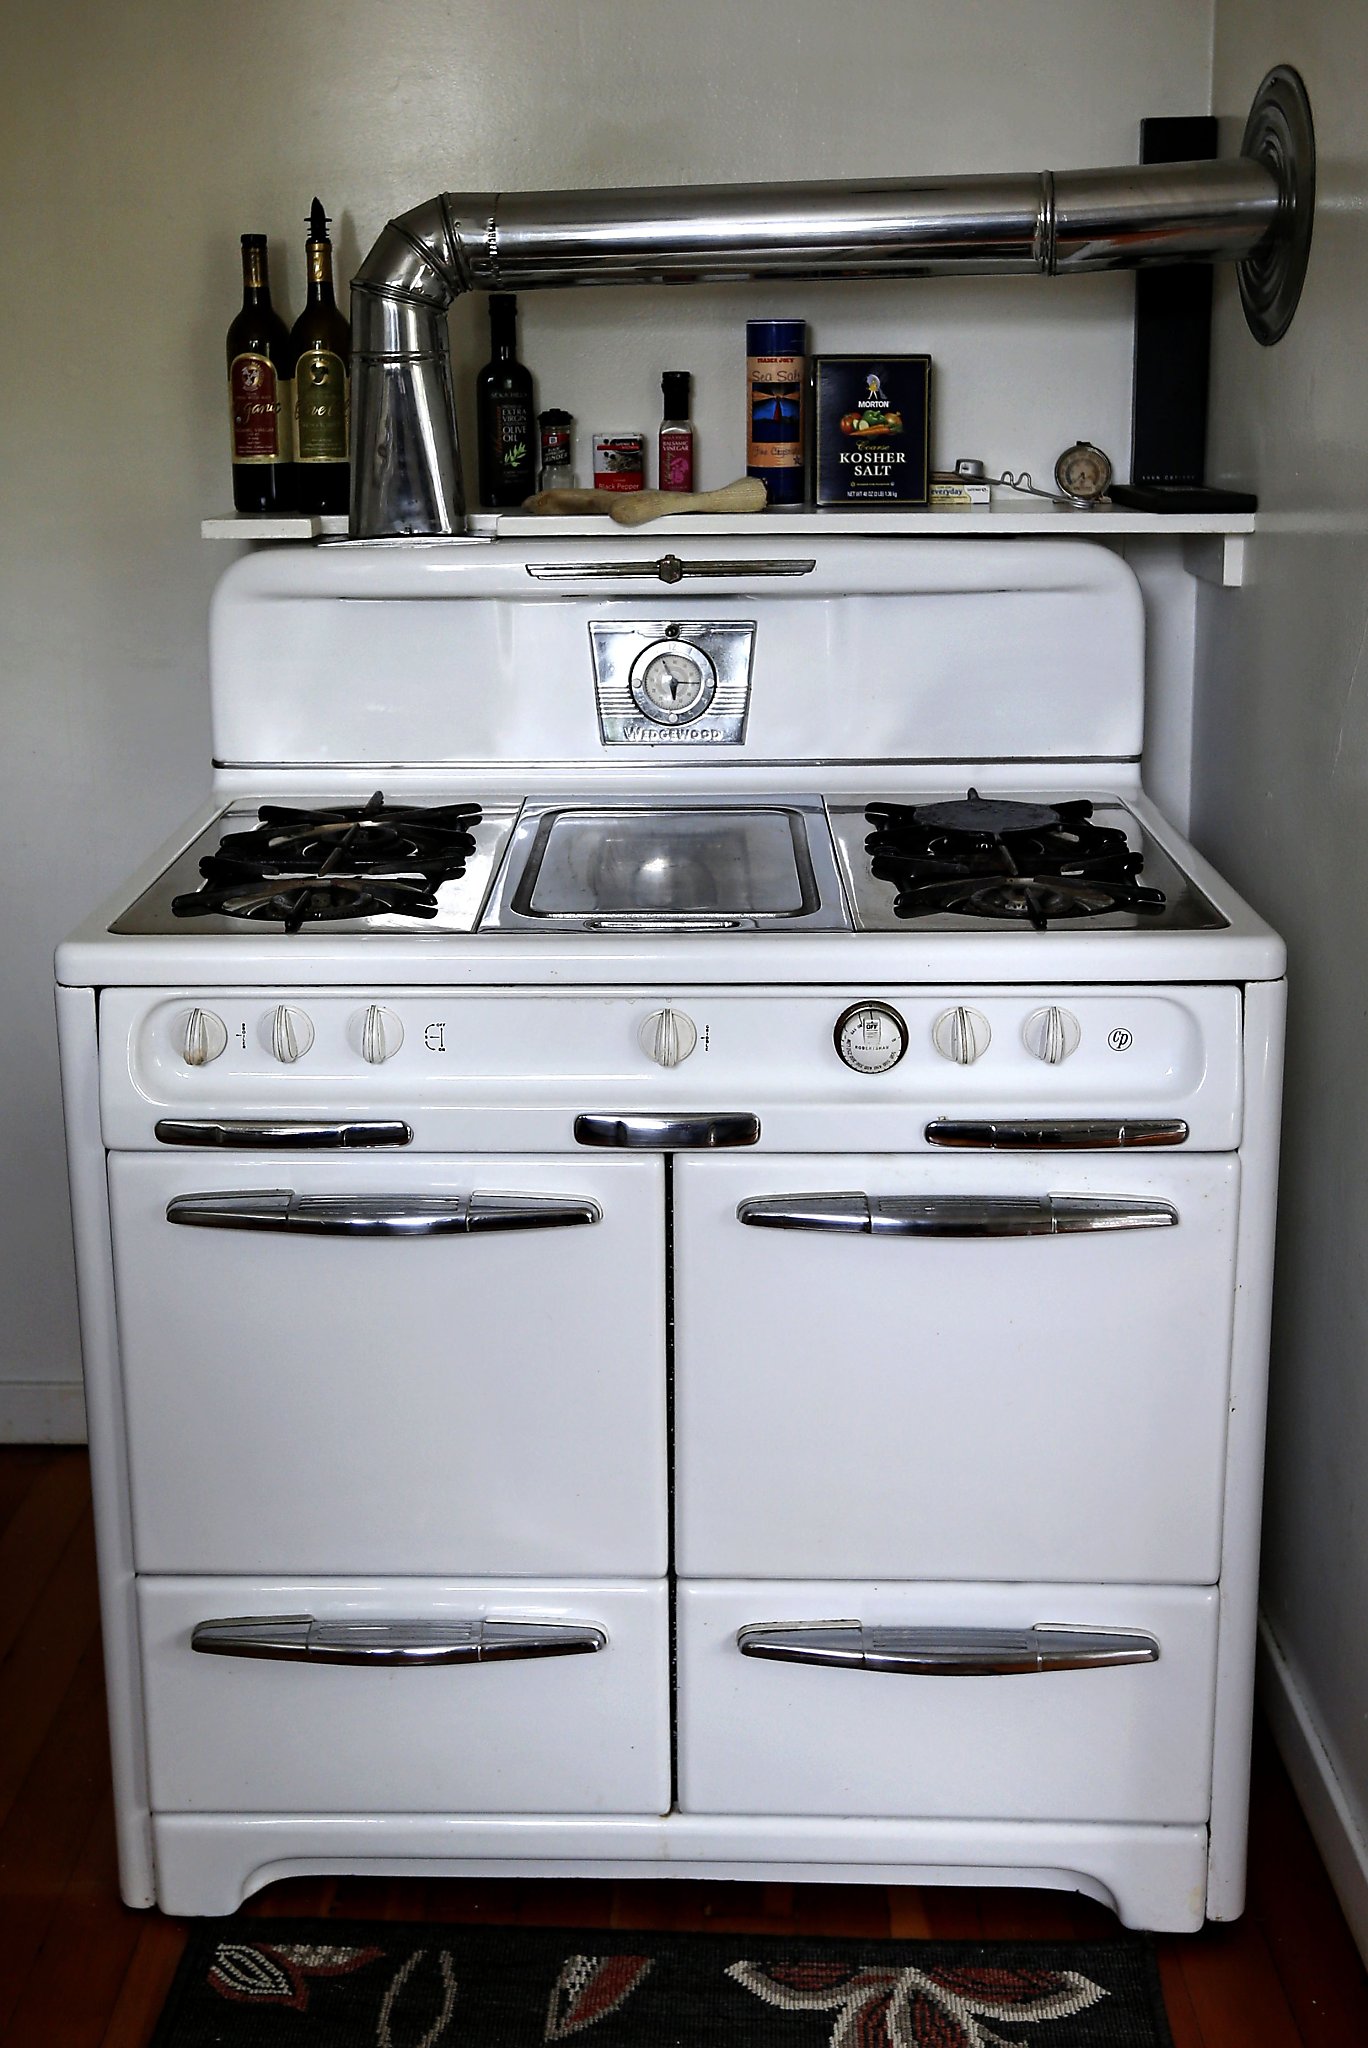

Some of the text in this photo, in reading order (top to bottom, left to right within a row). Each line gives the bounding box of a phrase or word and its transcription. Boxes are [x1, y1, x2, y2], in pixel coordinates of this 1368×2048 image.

[752, 370, 801, 382] Sea Salt
[858, 400, 890, 408] MORTON
[502, 426, 527, 434] OLIVE
[502, 434, 518, 442] OIL
[839, 452, 906, 464] KOSHER
[854, 465, 892, 477] SALT
[599, 482, 640, 491] Black Pepper
[929, 487, 963, 497] everyday
[623, 726, 724, 741] WEDGEWOOD
